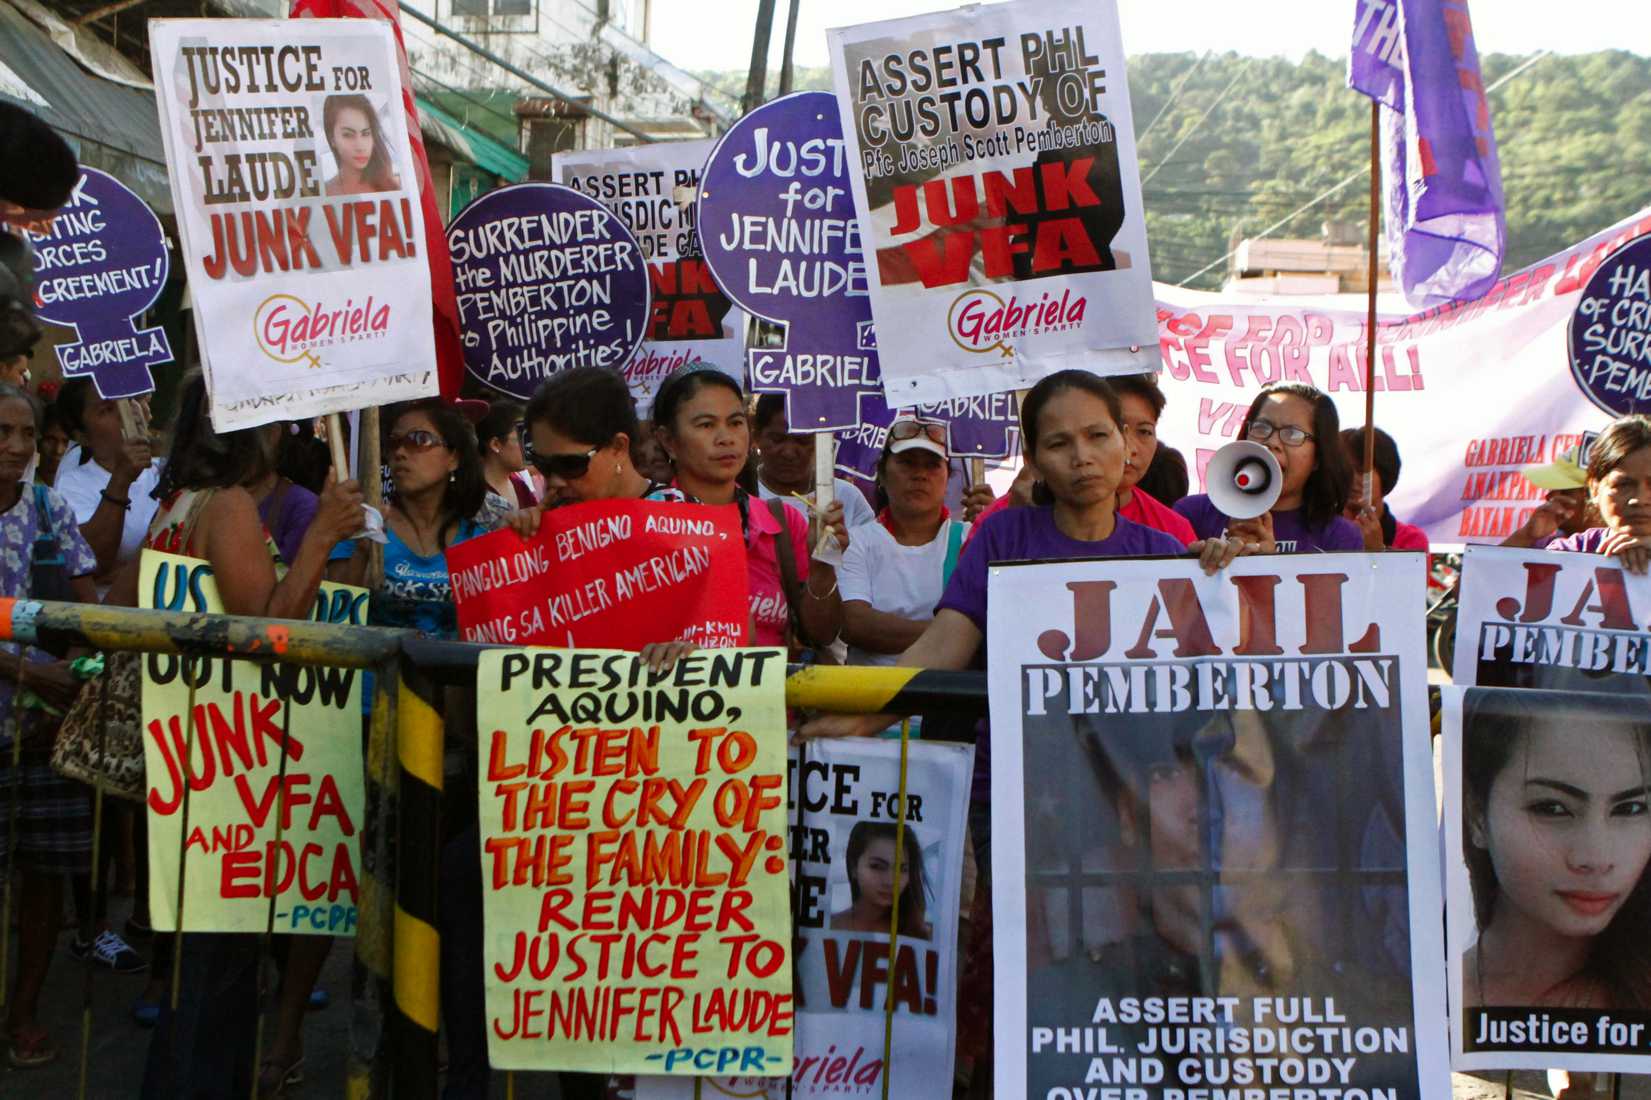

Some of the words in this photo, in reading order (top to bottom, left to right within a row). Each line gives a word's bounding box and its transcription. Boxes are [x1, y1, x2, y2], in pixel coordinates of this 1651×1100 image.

[181, 45, 326, 109] JUSTICE
[332, 66, 373, 92] FOR
[858, 37, 1007, 104] ASSERT
[1020, 25, 1100, 76] PHL
[190, 106, 314, 153] JENNIFER
[861, 76, 1044, 149] CUSTODY
[1056, 69, 1107, 118] OF
[733, 127, 847, 178] JUST
[862, 148, 894, 180] Pfc
[899, 134, 960, 175] Joseph
[964, 129, 1011, 160] Scott
[1014, 118, 1113, 155] Pemberton
[199, 149, 321, 206] LAUDE
[570, 170, 665, 199] ASSERT
[778, 181, 846, 218] for
[889, 155, 1102, 237] JUNK
[33, 239, 107, 272] ORCES
[203, 205, 322, 282] JUNK
[323, 197, 417, 267] VFA!
[448, 209, 613, 264] SURRENDER
[902, 217, 1104, 290] VFA
[37, 257, 163, 304] GREEMENT!
[455, 263, 496, 292] the
[498, 240, 635, 286] MURDERER
[748, 257, 869, 298] LAUDE
[264, 295, 391, 355] Gabriela
[456, 274, 612, 325] PEMBERTON
[957, 288, 1088, 346] Gabriela
[1579, 297, 1610, 321] OF
[62, 332, 166, 372] GABRIELA
[486, 319, 634, 382] Authorities!
[487, 309, 614, 351] Philippine
[1043, 321, 1083, 334] PARTY
[754, 353, 882, 388] GABRIEL
[1224, 340, 1315, 388] FOR
[1327, 343, 1425, 392] ALL!
[1464, 433, 1546, 468] GABRIELA
[1458, 507, 1514, 537] BAYAN
[451, 545, 550, 604] PANGULONG
[556, 514, 632, 562] BENIGNO
[645, 514, 728, 541] AQUINO,
[519, 605, 546, 638] SA
[547, 578, 613, 628] KILLER
[614, 545, 712, 602] AMERICAN
[1036, 573, 1381, 662] JAIL
[1480, 625, 1651, 677] PEMBE
[525, 688, 743, 726] AQUINO,
[1026, 659, 1391, 716] PEMBERTON
[146, 689, 304, 816] JUNK
[487, 723, 661, 782] LISTEN
[687, 726, 758, 776] TO
[234, 772, 355, 837] VFA
[494, 779, 596, 833] THE
[601, 777, 708, 831] CRY
[712, 773, 784, 833] OF
[869, 790, 923, 823] FOR
[185, 822, 256, 854] AND
[484, 833, 575, 890] THE
[586, 829, 785, 890] FAMILY:
[219, 839, 359, 904] EDCA
[537, 886, 756, 933] RENDER
[493, 931, 702, 983] JUSTICE
[719, 933, 786, 981] TO
[822, 937, 940, 1018] VFA!
[492, 985, 684, 1048] JENNIFER
[691, 986, 794, 1038] LAUDE
[1092, 996, 1240, 1024] ASSERT
[1253, 996, 1346, 1024] FULL
[1475, 1012, 1589, 1044] Justice
[1596, 1015, 1645, 1047] for
[644, 1046, 783, 1073] -PCPR-
[791, 1044, 884, 1088] riela
[1032, 1027, 1125, 1054] PHIL.
[1137, 1026, 1409, 1054] JURISDICTION
[1084, 1057, 1164, 1084] AND
[1178, 1057, 1357, 1084] CUSTODY
